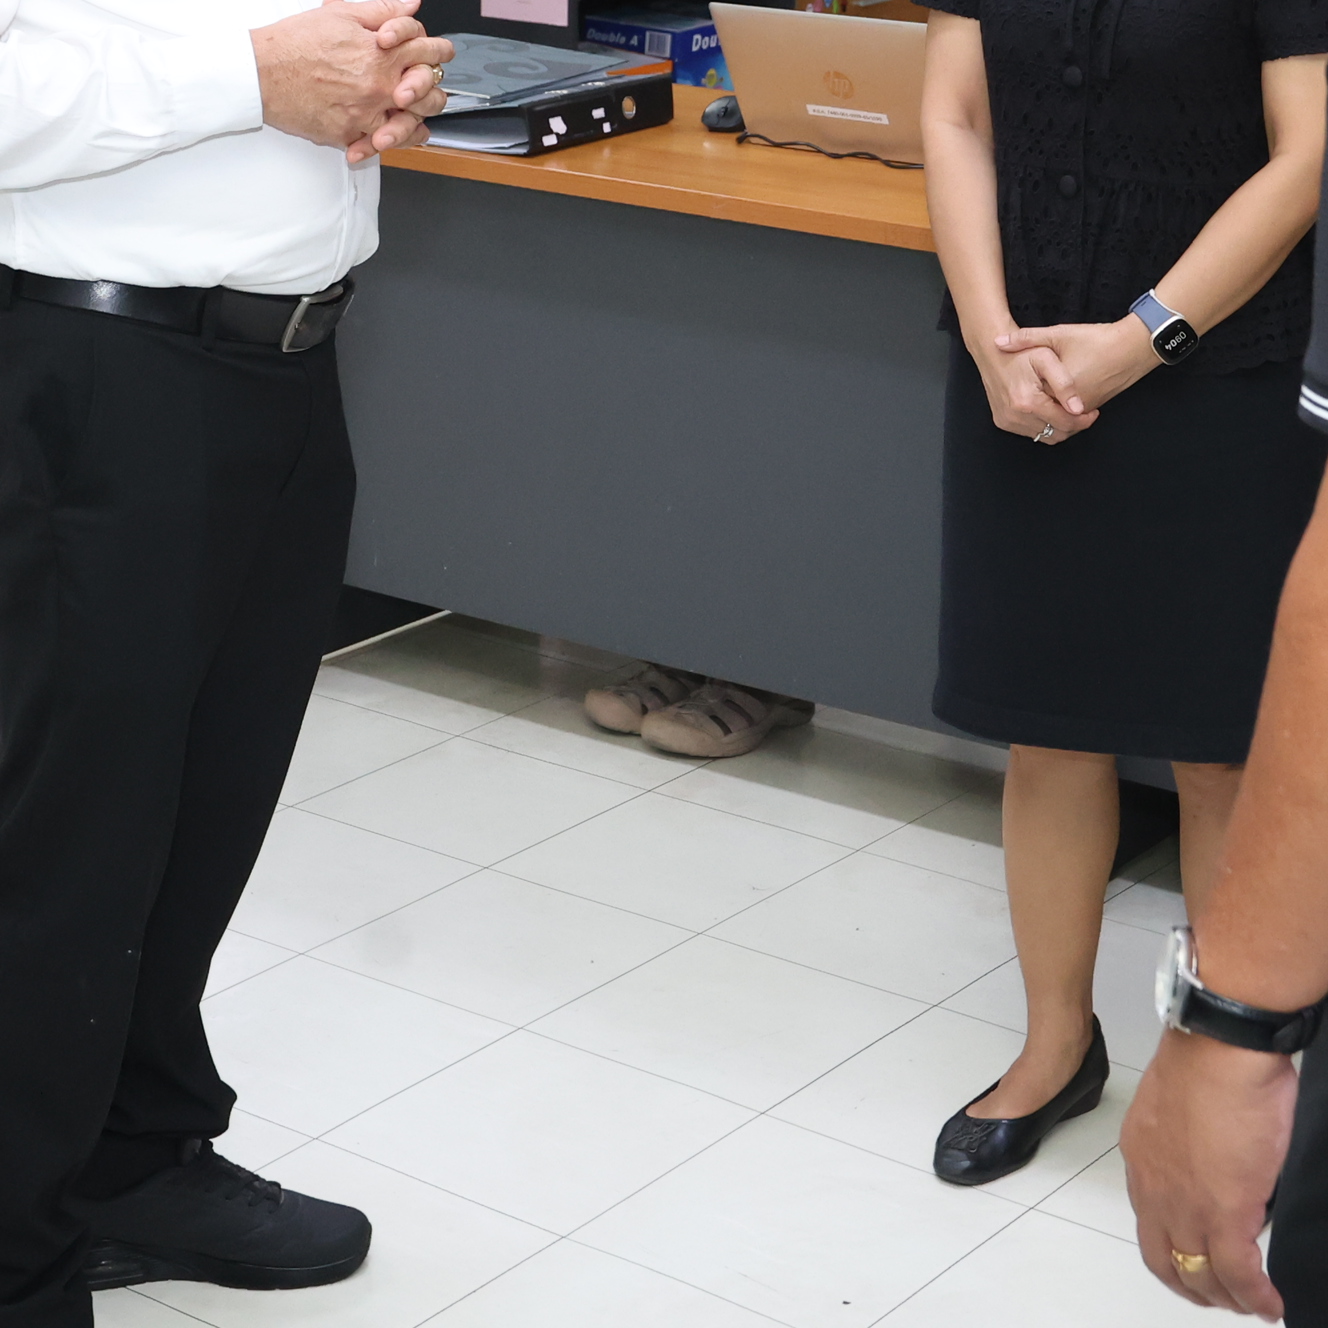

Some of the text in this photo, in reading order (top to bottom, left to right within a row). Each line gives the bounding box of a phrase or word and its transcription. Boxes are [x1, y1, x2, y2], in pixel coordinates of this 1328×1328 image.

[586, 27, 639, 47] Double A
[692, 33, 721, 53] Dou
